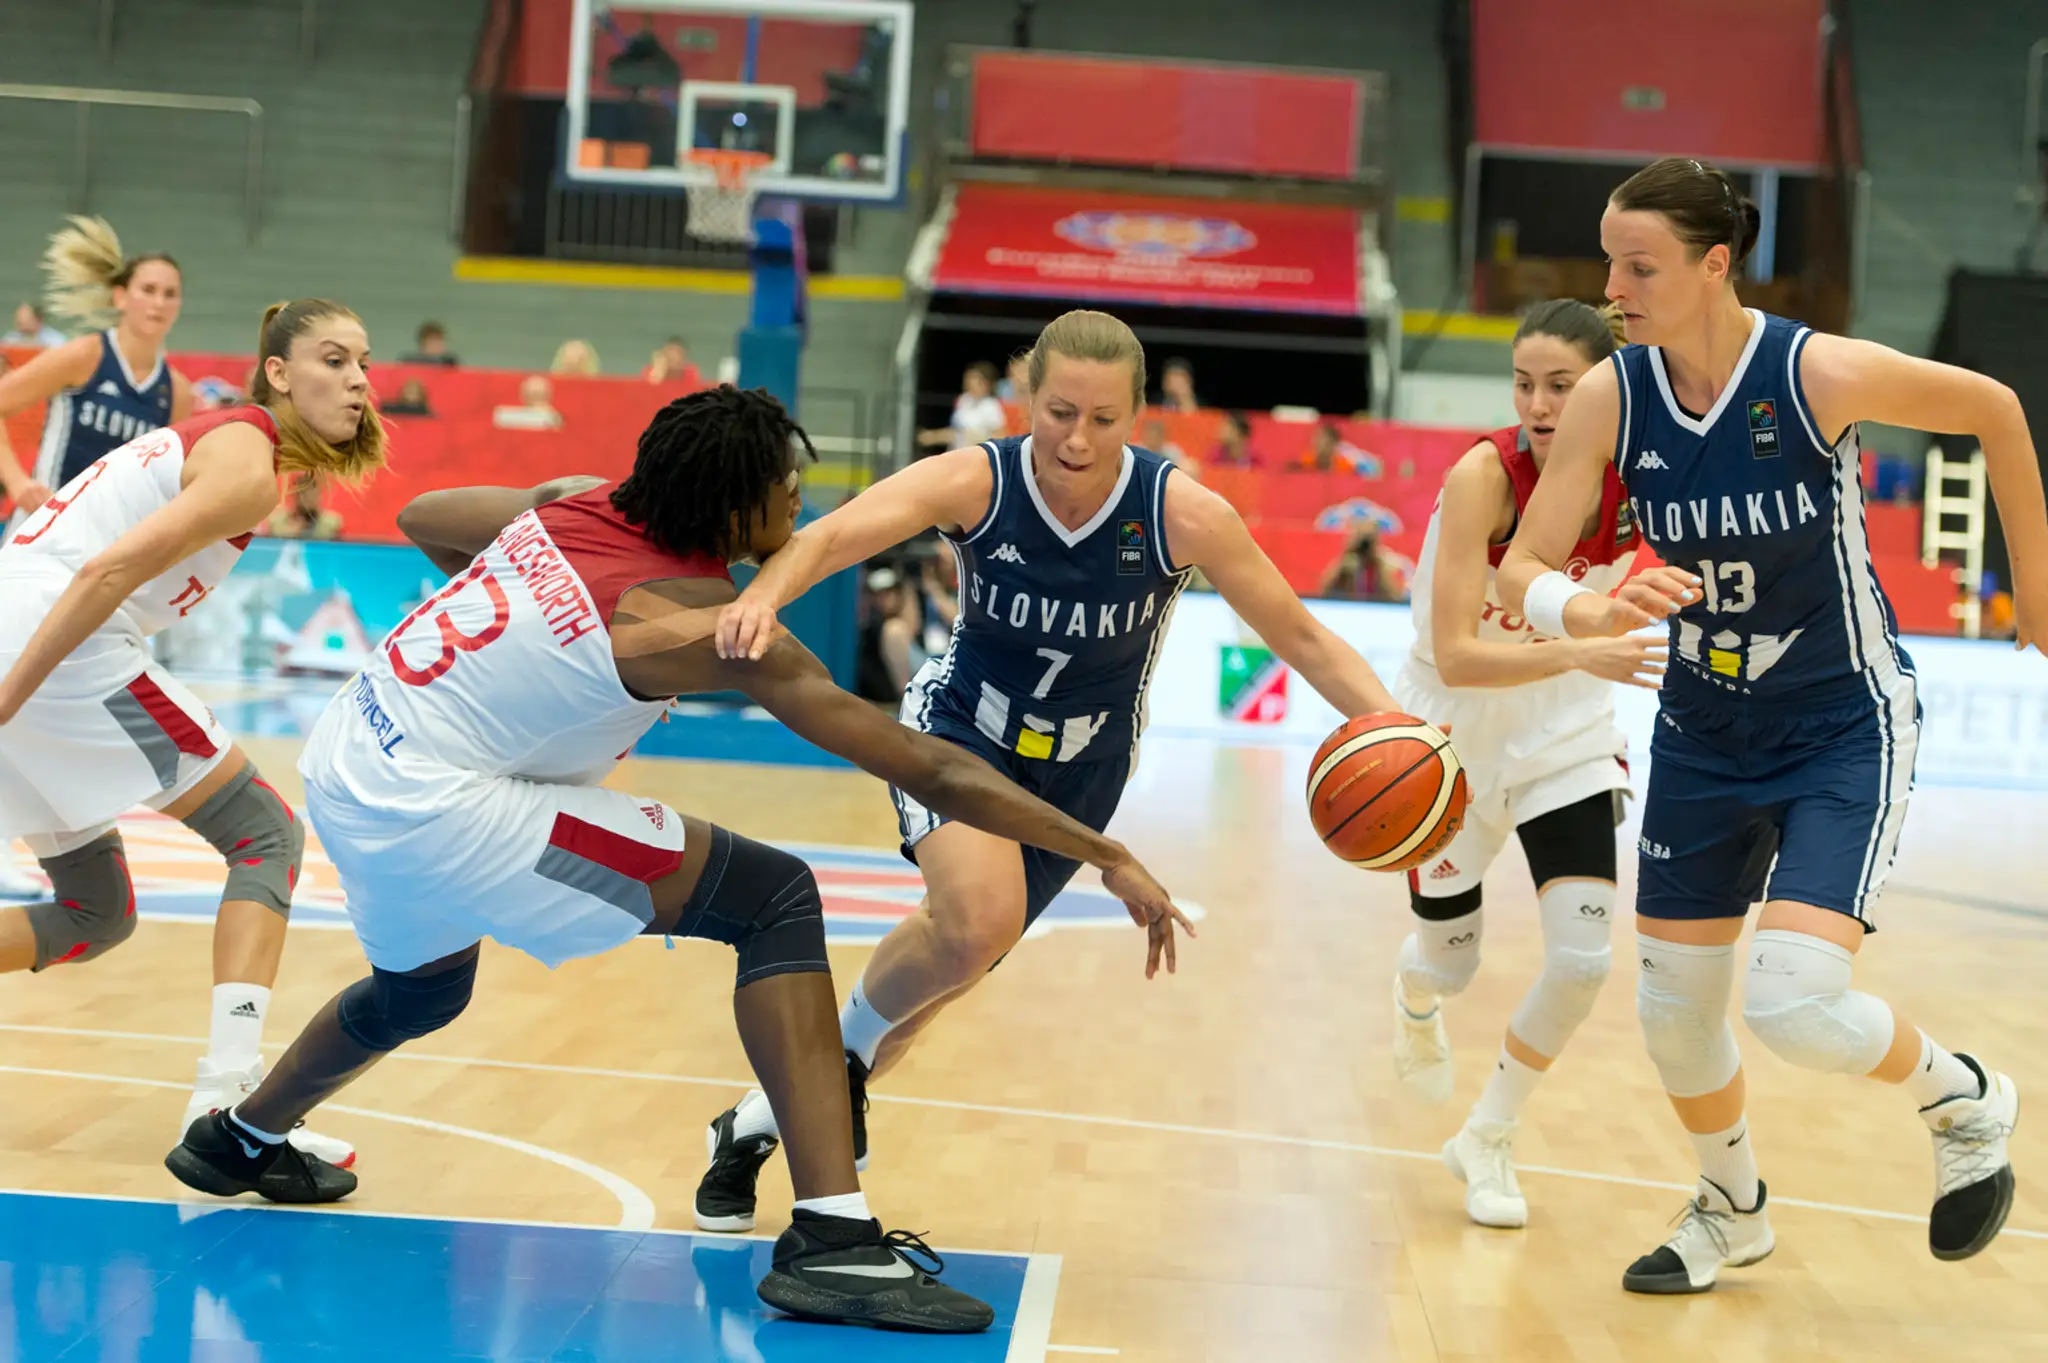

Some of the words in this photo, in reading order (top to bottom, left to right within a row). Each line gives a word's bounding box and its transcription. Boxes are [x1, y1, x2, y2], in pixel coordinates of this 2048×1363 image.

[1755, 431, 1775, 444] FIBA
[1630, 481, 1818, 542] SLOVAKIA
[1121, 551, 1141, 562] FIBA
[970, 571, 1156, 639] SLOVAKIA
[1697, 559, 1756, 616] 13
[1029, 647, 1074, 700] 7
